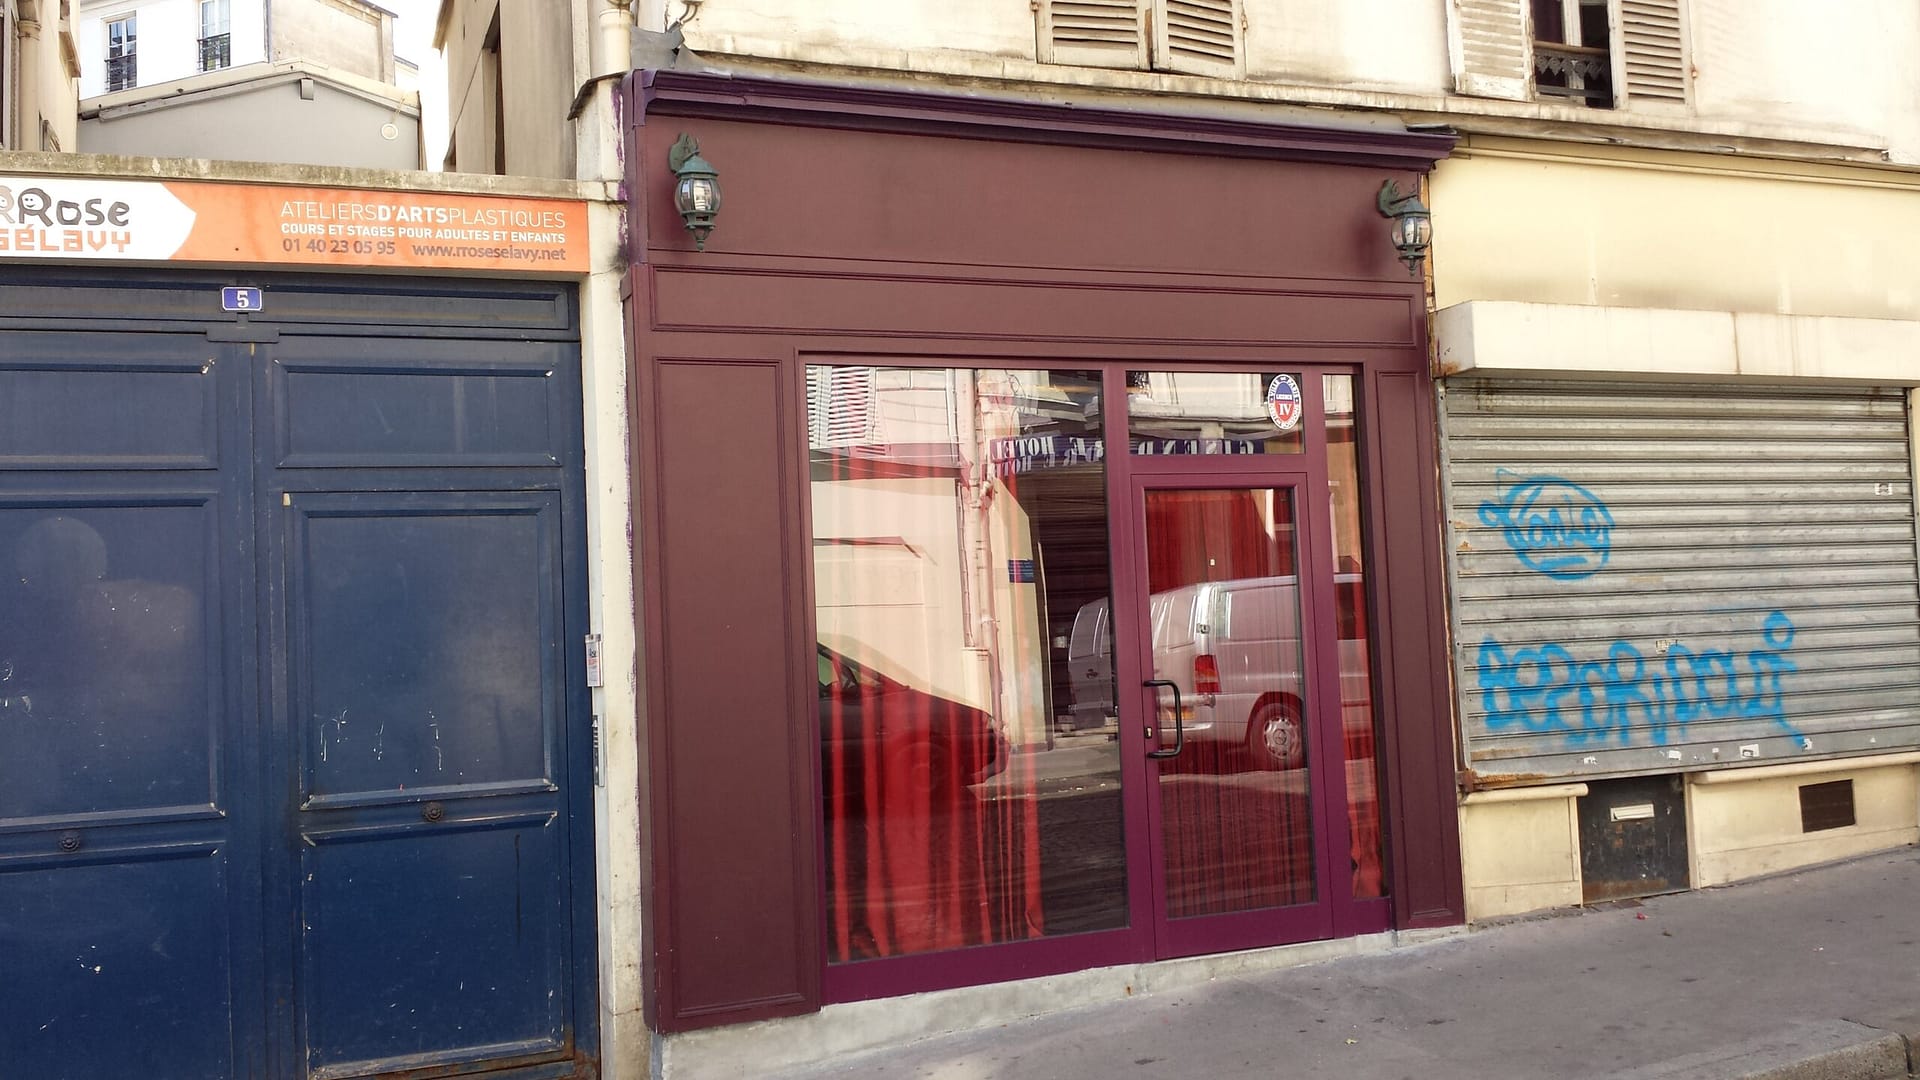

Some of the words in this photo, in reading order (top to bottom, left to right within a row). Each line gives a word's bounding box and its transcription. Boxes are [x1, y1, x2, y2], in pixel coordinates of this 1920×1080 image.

[281, 223, 325, 235] COURS
[328, 224, 344, 236] ET
[347, 225, 395, 237] STAGES
[398, 227, 432, 239] POUR
[435, 229, 490, 241] ADULTES
[493, 230, 508, 242] ET
[511, 231, 566, 244] ENFANTS
[282, 239, 300, 252] 01
[306, 239, 327, 253] 40
[330, 240, 349, 254] 23
[353, 240, 373, 255] 05
[377, 241, 396, 255] 95
[237, 290, 249, 308] 5
[1278, 403, 1293, 417] IV
